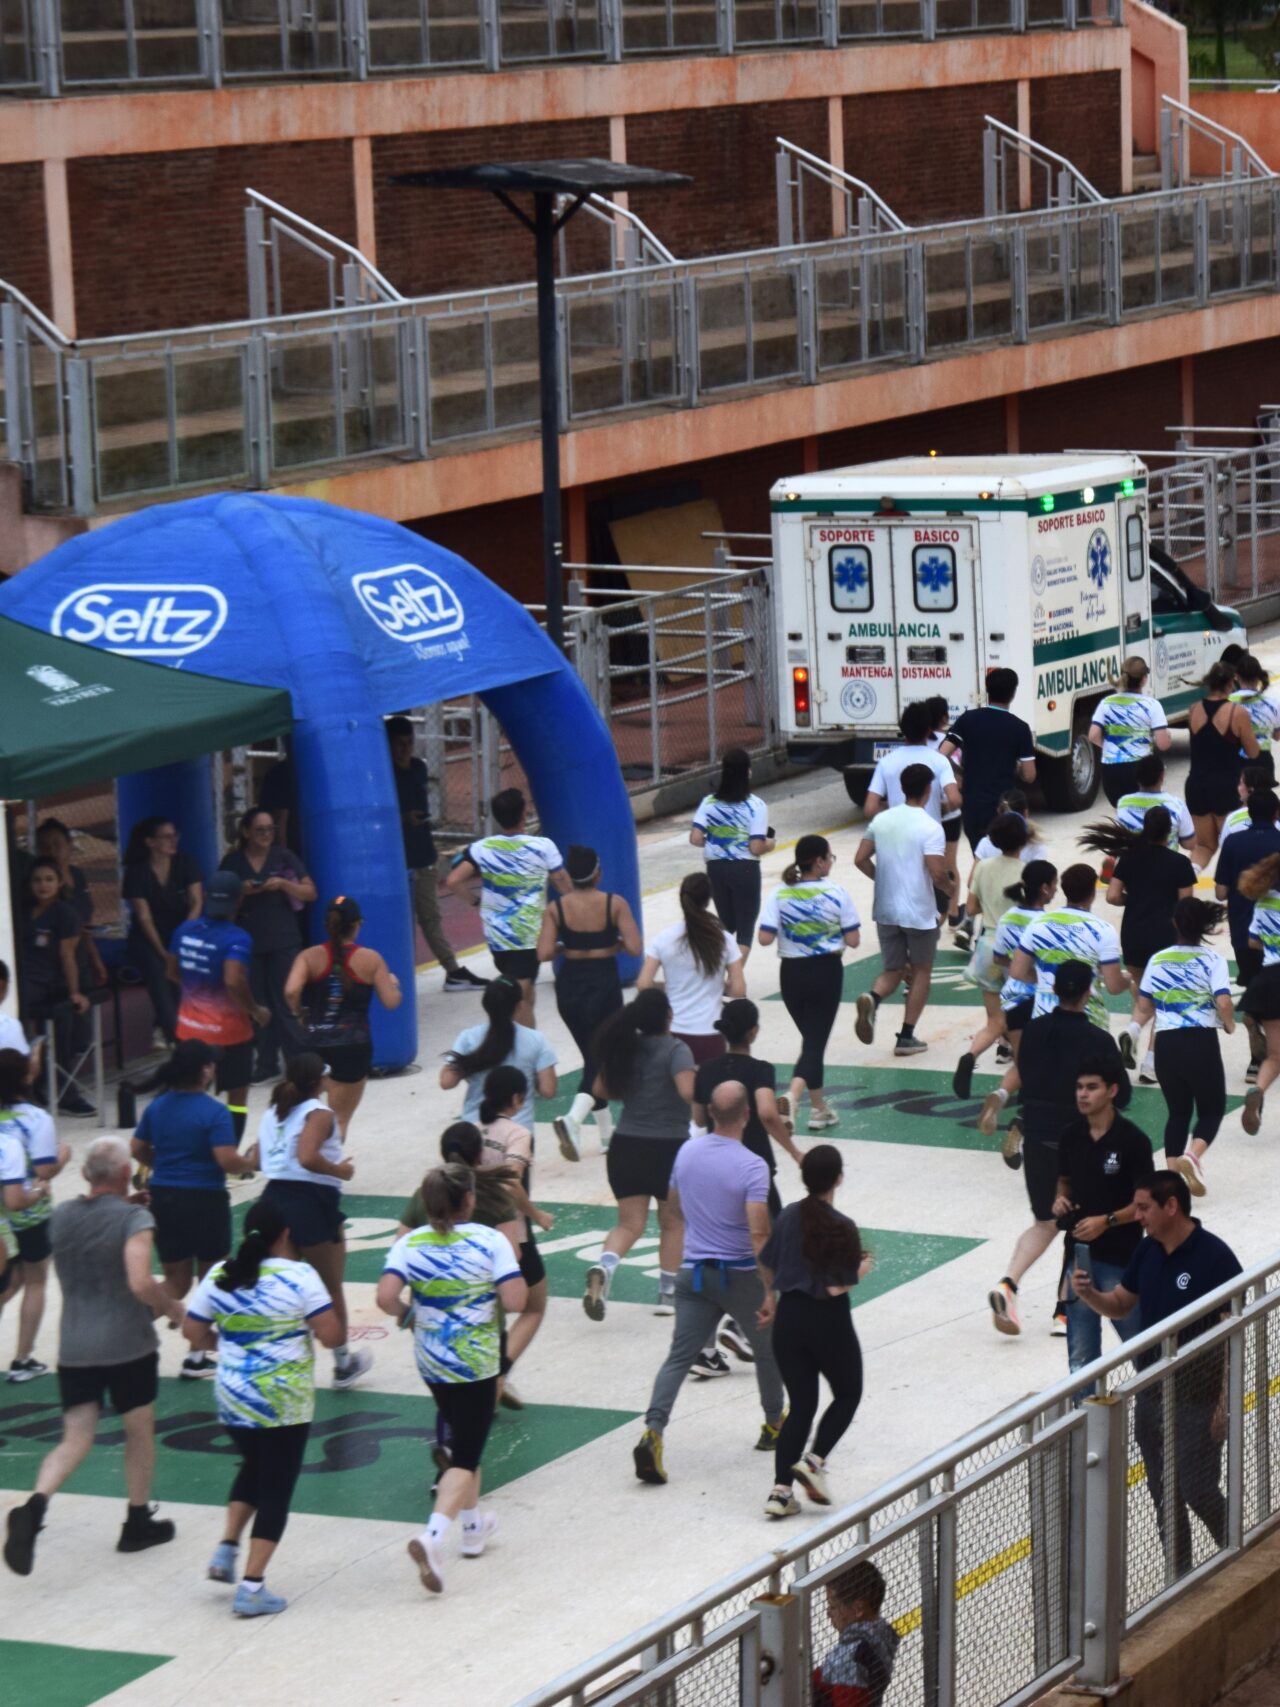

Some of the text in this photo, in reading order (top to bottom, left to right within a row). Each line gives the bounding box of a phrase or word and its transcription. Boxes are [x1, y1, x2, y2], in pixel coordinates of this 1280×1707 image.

[1038, 515, 1074, 533] SOPORTE
[819, 529, 875, 542] SOPORTE
[361, 578, 458, 631] Seltz
[65, 594, 213, 643] Seltz
[848, 623, 941, 638] AMBULANCIA
[841, 666, 952, 679] MANTENGA DISTANCIA
[1037, 655, 1119, 699] AMBULANCA
